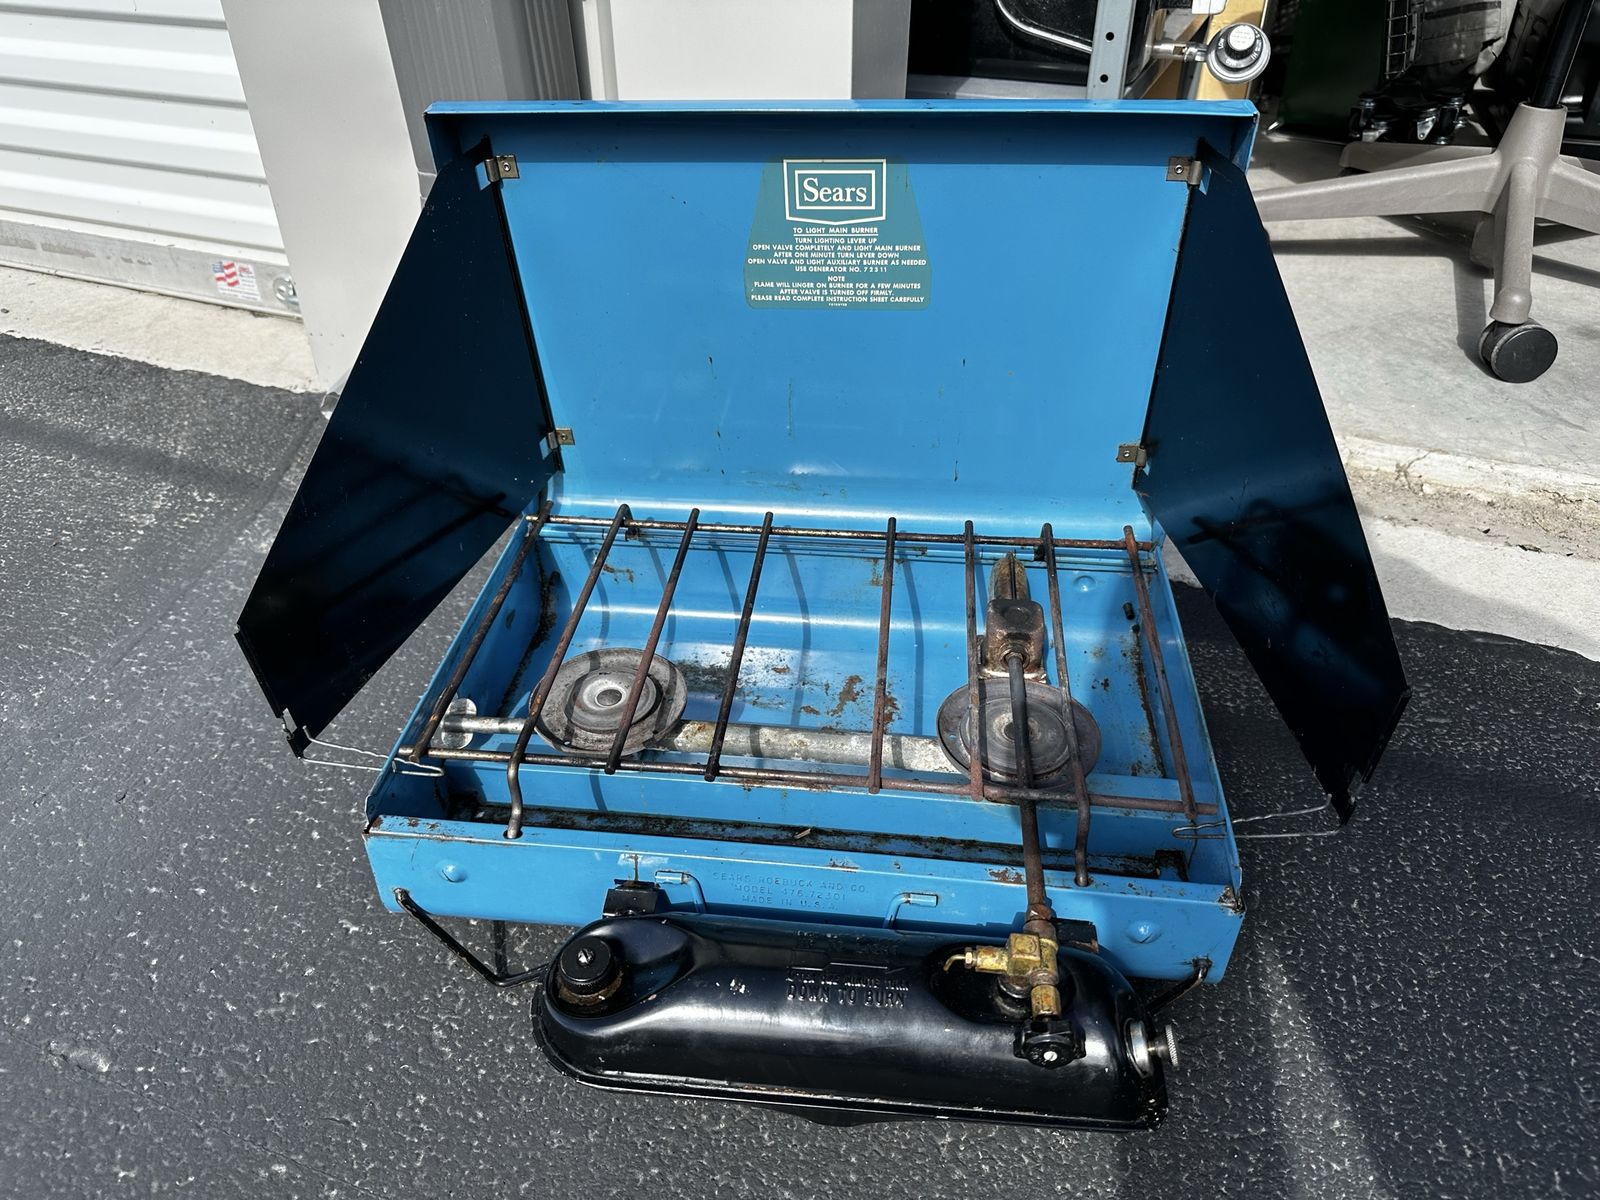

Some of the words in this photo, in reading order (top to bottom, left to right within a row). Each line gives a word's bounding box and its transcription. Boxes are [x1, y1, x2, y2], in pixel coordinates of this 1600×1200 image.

[803, 177, 867, 203] Sears
[735, 884, 773, 895] MODEL
[758, 876, 813, 888] ROEBUCK
[820, 881, 844, 892] AND
[850, 884, 870, 894] CO.
[742, 894, 773, 905] MADE
[781, 898, 793, 907] IN
